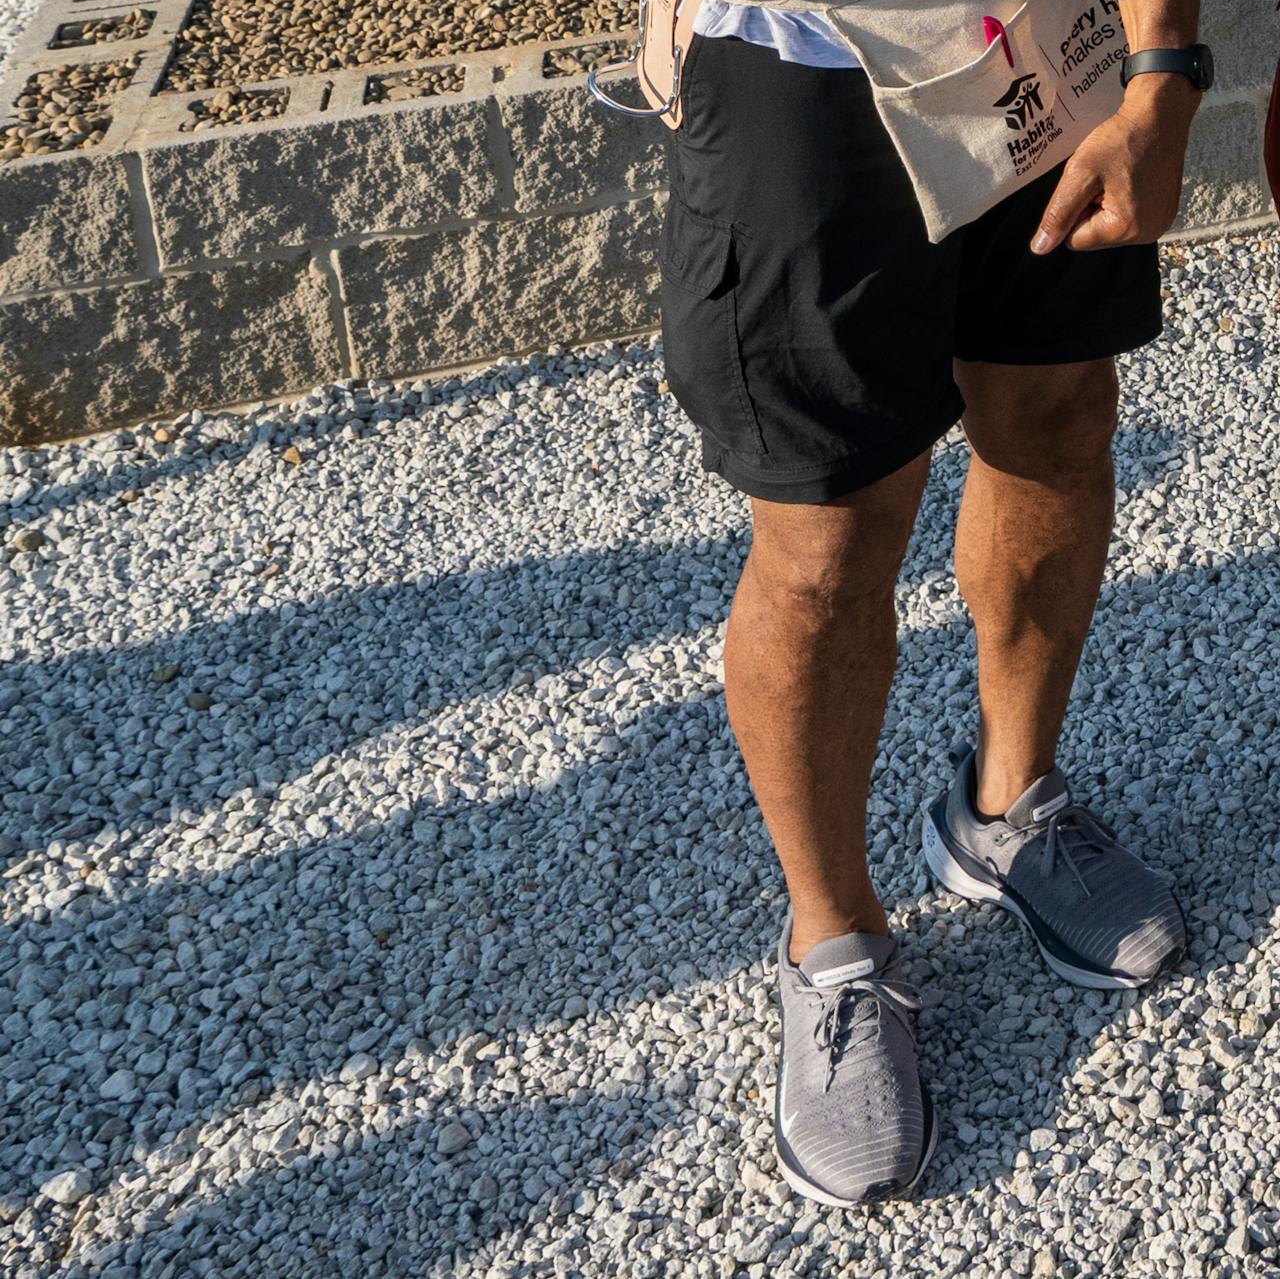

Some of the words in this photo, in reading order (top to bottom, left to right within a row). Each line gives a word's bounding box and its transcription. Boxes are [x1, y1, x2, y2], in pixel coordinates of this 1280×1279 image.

[1062, 24, 1116, 77] makes
[1072, 43, 1130, 98] habitatec
[1013, 154, 1027, 167] for
[1016, 161, 1032, 176] East
[1048, 127, 1063, 142] Ohio
